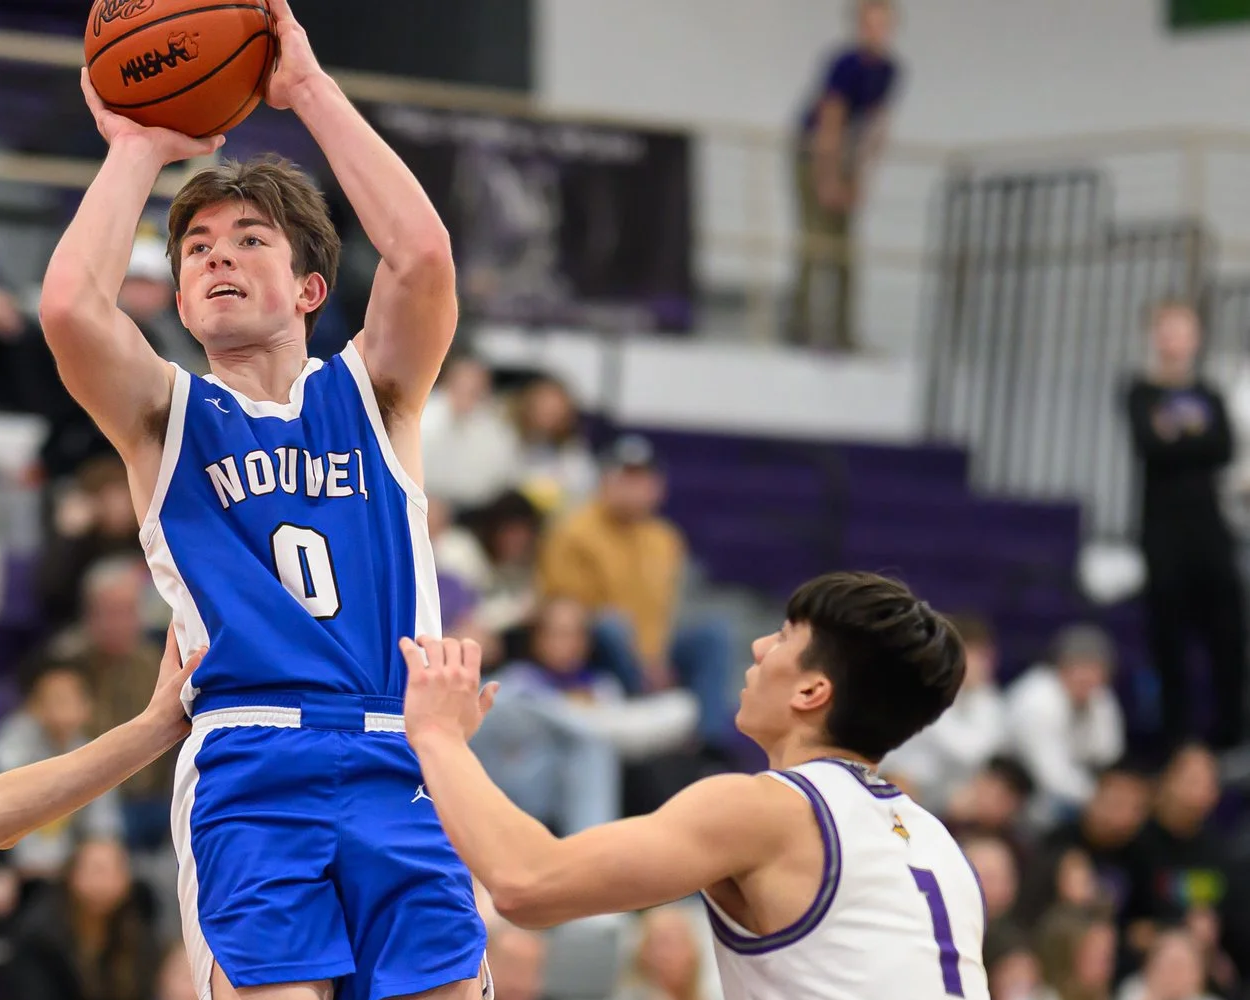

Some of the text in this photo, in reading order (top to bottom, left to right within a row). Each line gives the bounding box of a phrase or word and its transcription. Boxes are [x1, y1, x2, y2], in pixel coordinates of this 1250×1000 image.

[119, 43, 189, 87] MHSAA
[269, 521, 343, 620] 0
[907, 864, 965, 999] 1
